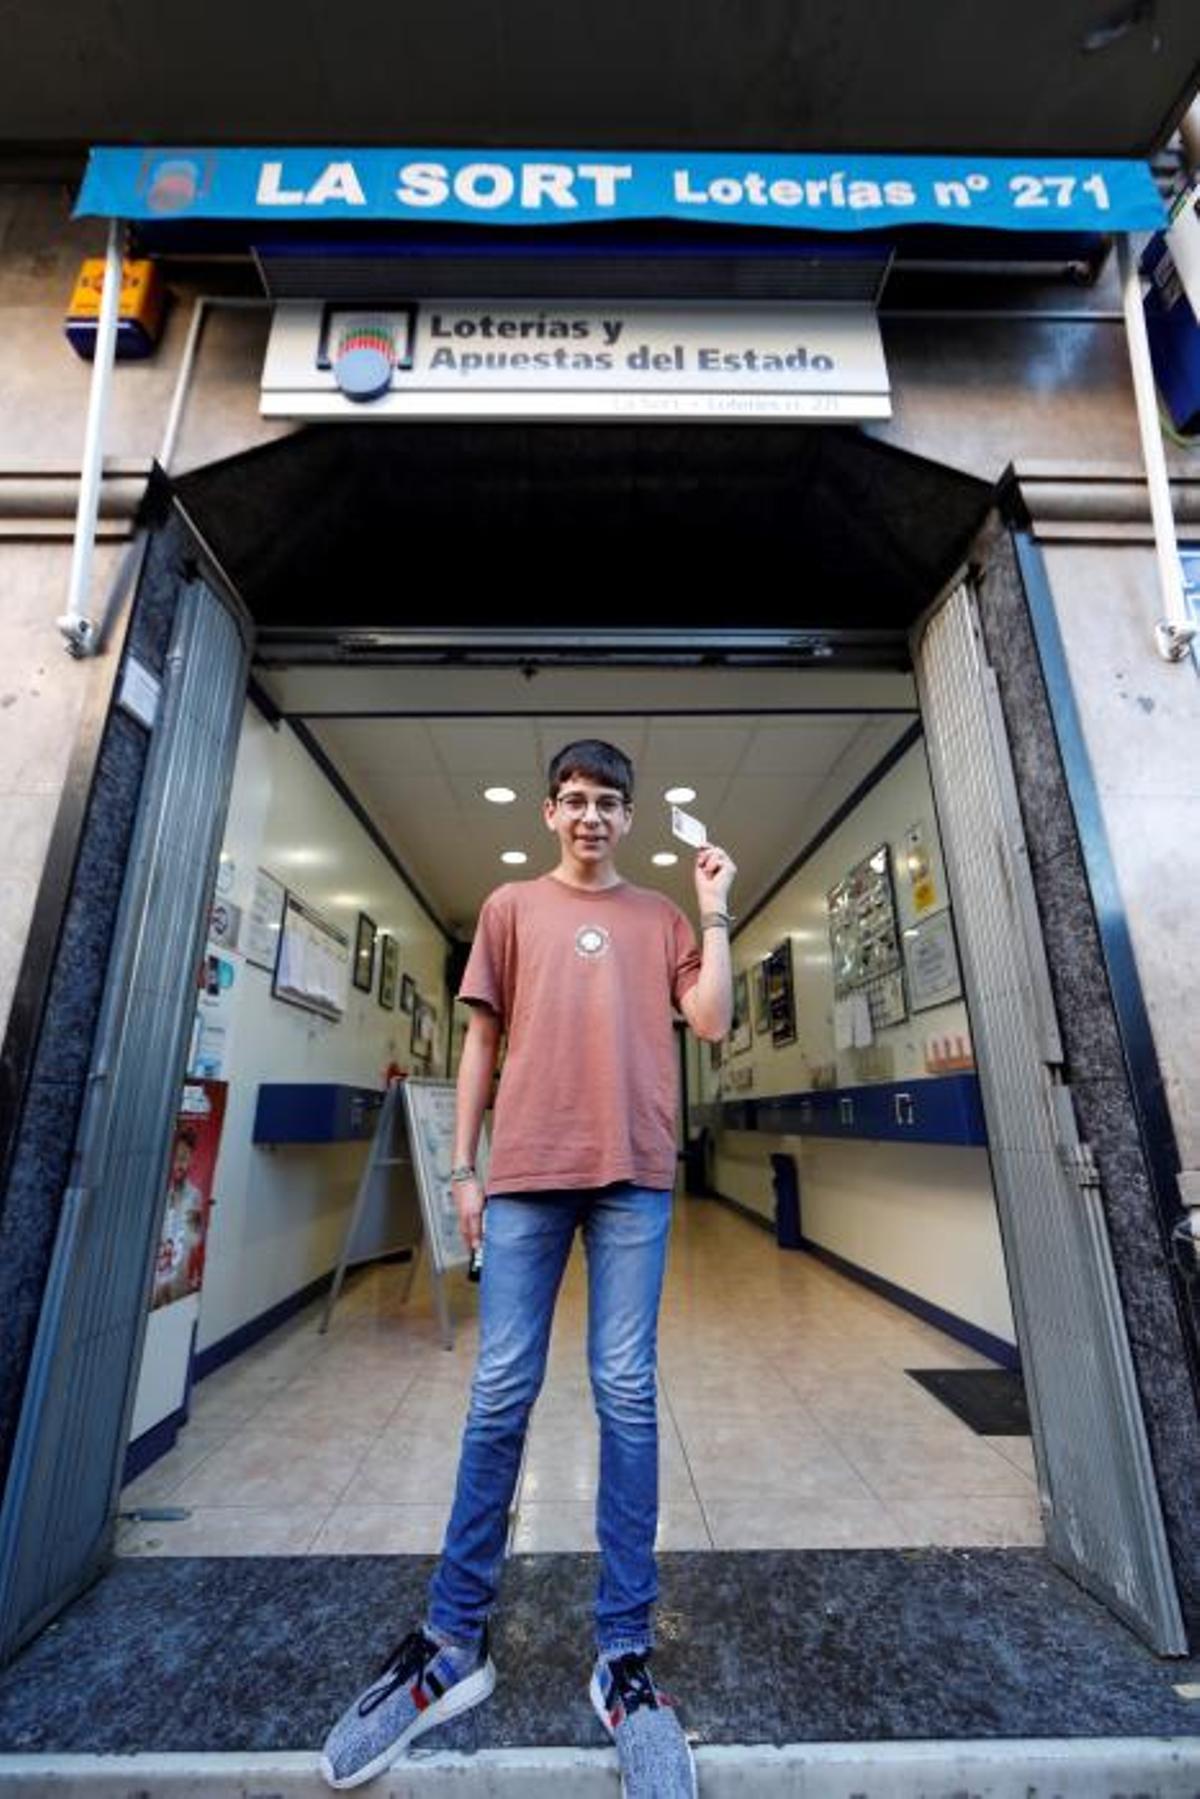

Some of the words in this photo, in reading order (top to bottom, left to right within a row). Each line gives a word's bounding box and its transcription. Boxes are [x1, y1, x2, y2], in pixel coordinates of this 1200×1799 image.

[255, 162, 366, 207] LA
[396, 163, 632, 208] SORT
[673, 170, 916, 210] Loterías
[1008, 173, 1110, 210] 271
[602, 319, 623, 345] y
[429, 347, 613, 375] Apuestas
[626, 345, 684, 371] del
[697, 347, 835, 372] Estado
